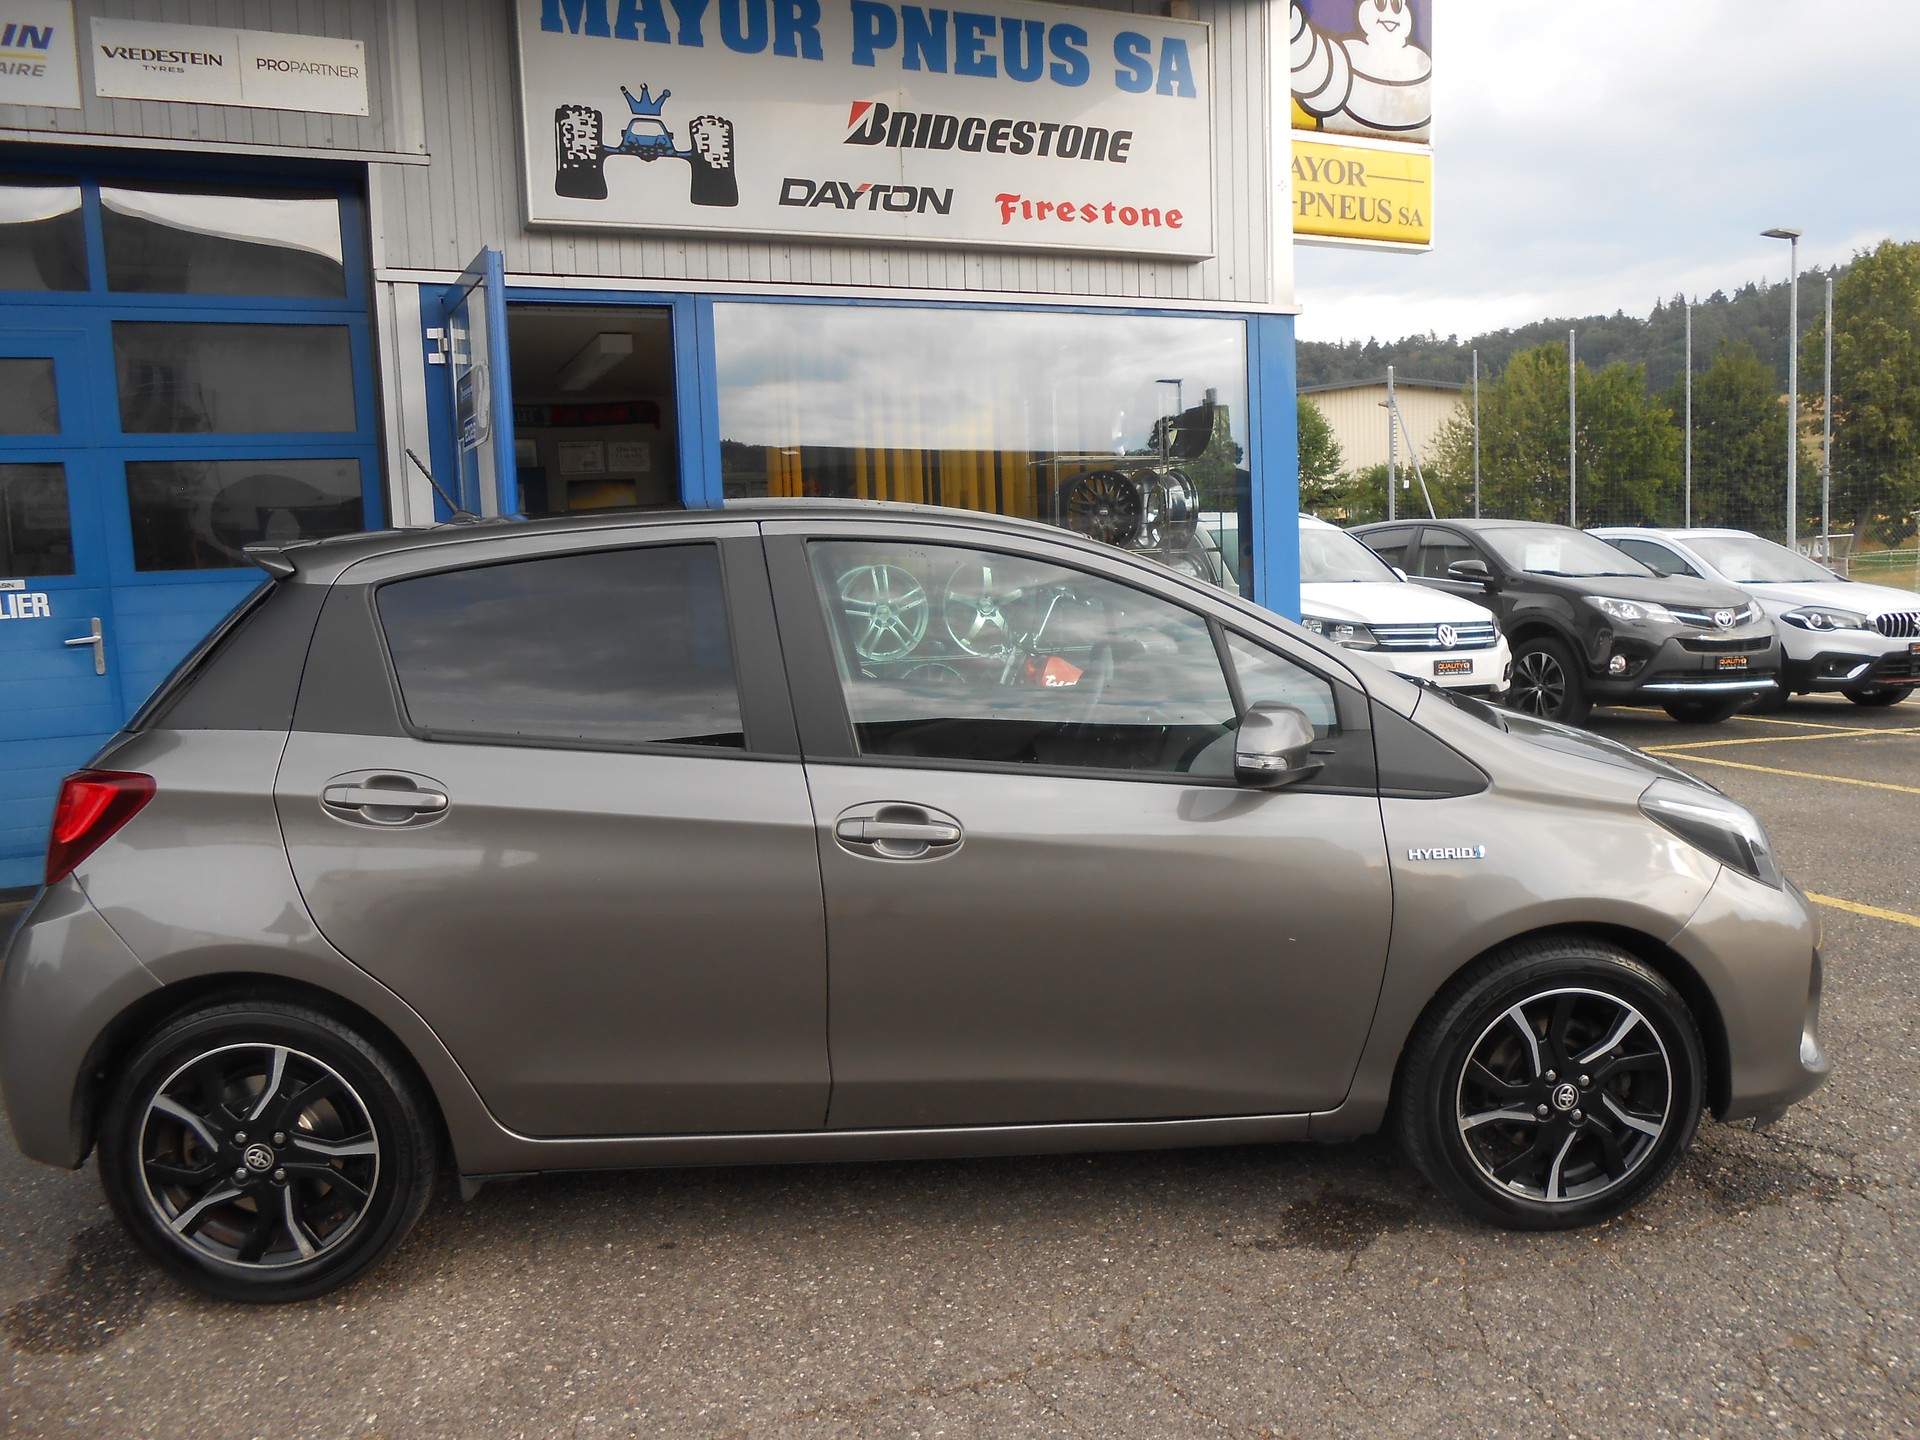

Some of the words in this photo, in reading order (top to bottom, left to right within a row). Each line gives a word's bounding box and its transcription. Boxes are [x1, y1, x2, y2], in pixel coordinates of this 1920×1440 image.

[101, 45, 223, 66] VREDESTEIN
[851, 0, 1090, 88] PNEUS
[1113, 31, 1197, 98] SA
[142, 64, 185, 74] TYRES
[256, 57, 360, 79] PROPARTNER
[844, 101, 1133, 164] BRIDGESTONE
[779, 177, 954, 215] DAYTON
[995, 193, 1185, 229] Firestone
[1398, 206, 1424, 227] SA
[1408, 847, 1475, 860] HYBRID
